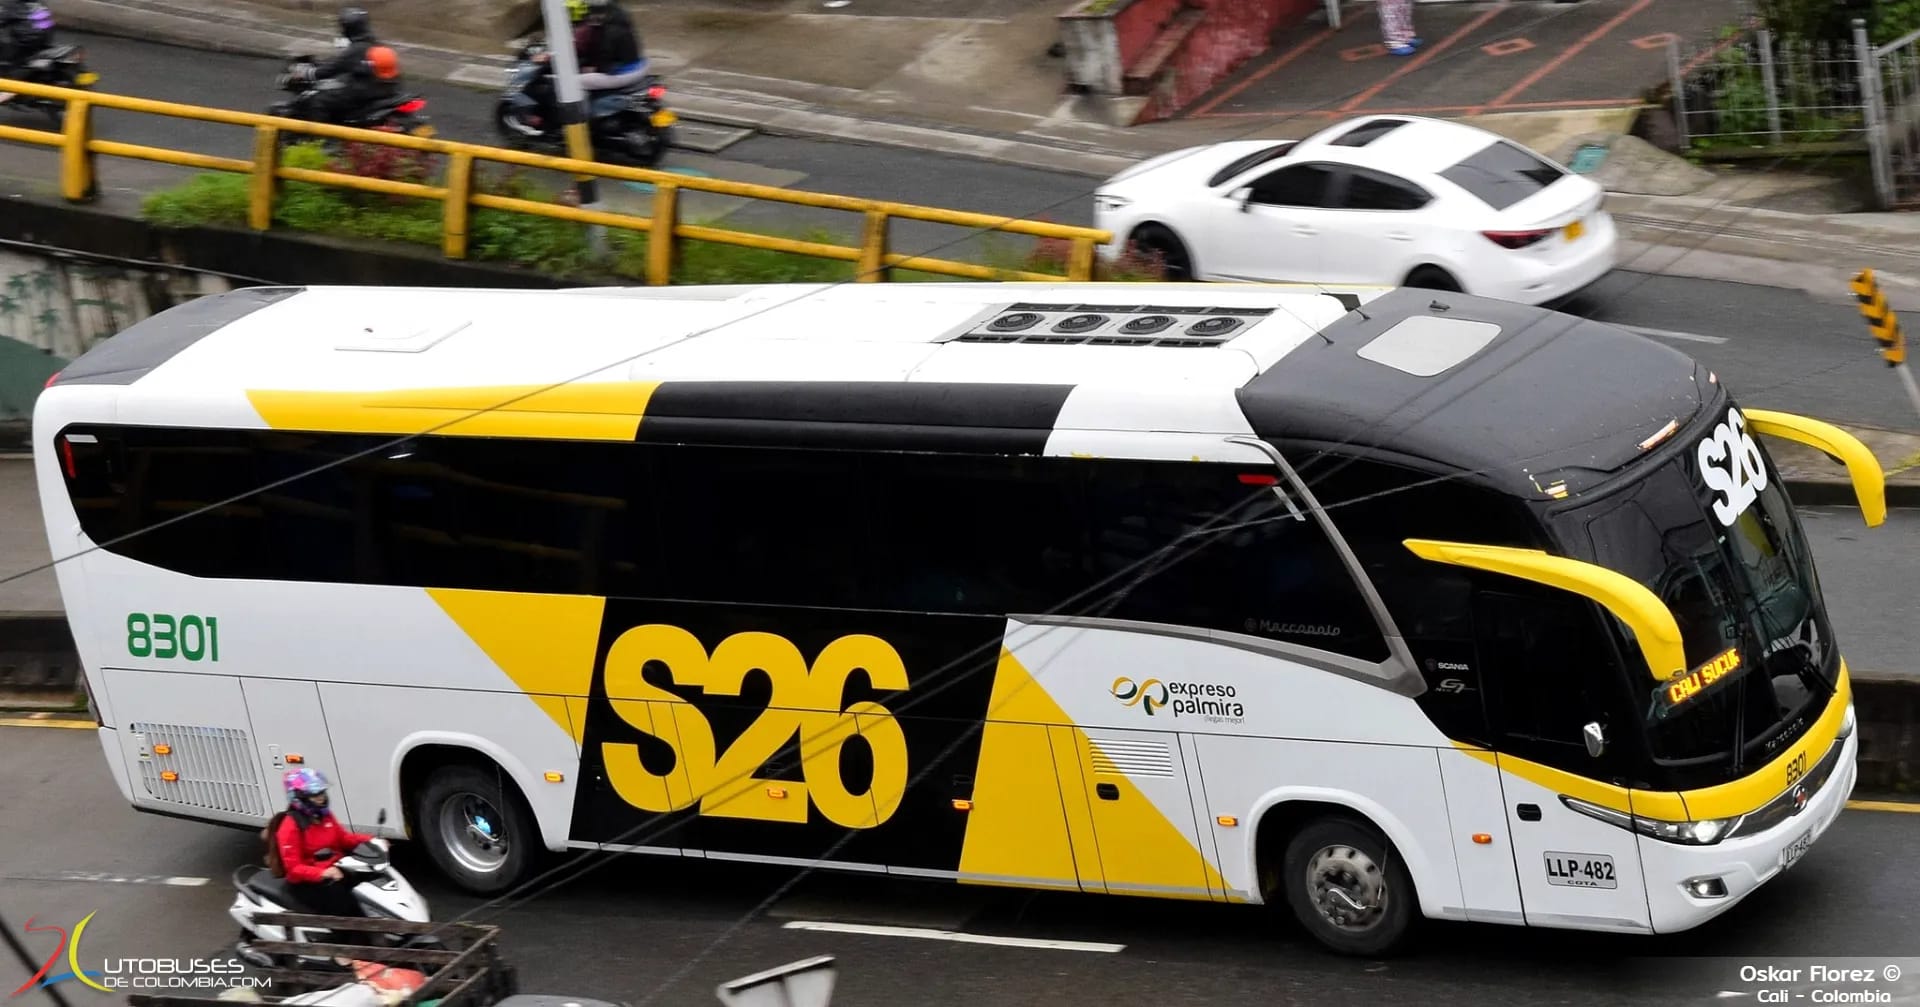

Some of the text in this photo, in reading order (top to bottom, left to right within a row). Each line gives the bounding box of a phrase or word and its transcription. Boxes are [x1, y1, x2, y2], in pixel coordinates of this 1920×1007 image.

[1698, 408, 1767, 526] S26
[127, 612, 218, 661] 8301
[1169, 681, 1236, 699] expreso
[1670, 672, 1701, 703] CALI
[1173, 697, 1244, 718] palmira
[601, 623, 910, 829] S26
[1786, 750, 1806, 785] 8301
[1546, 858, 1615, 880] LLP-482
